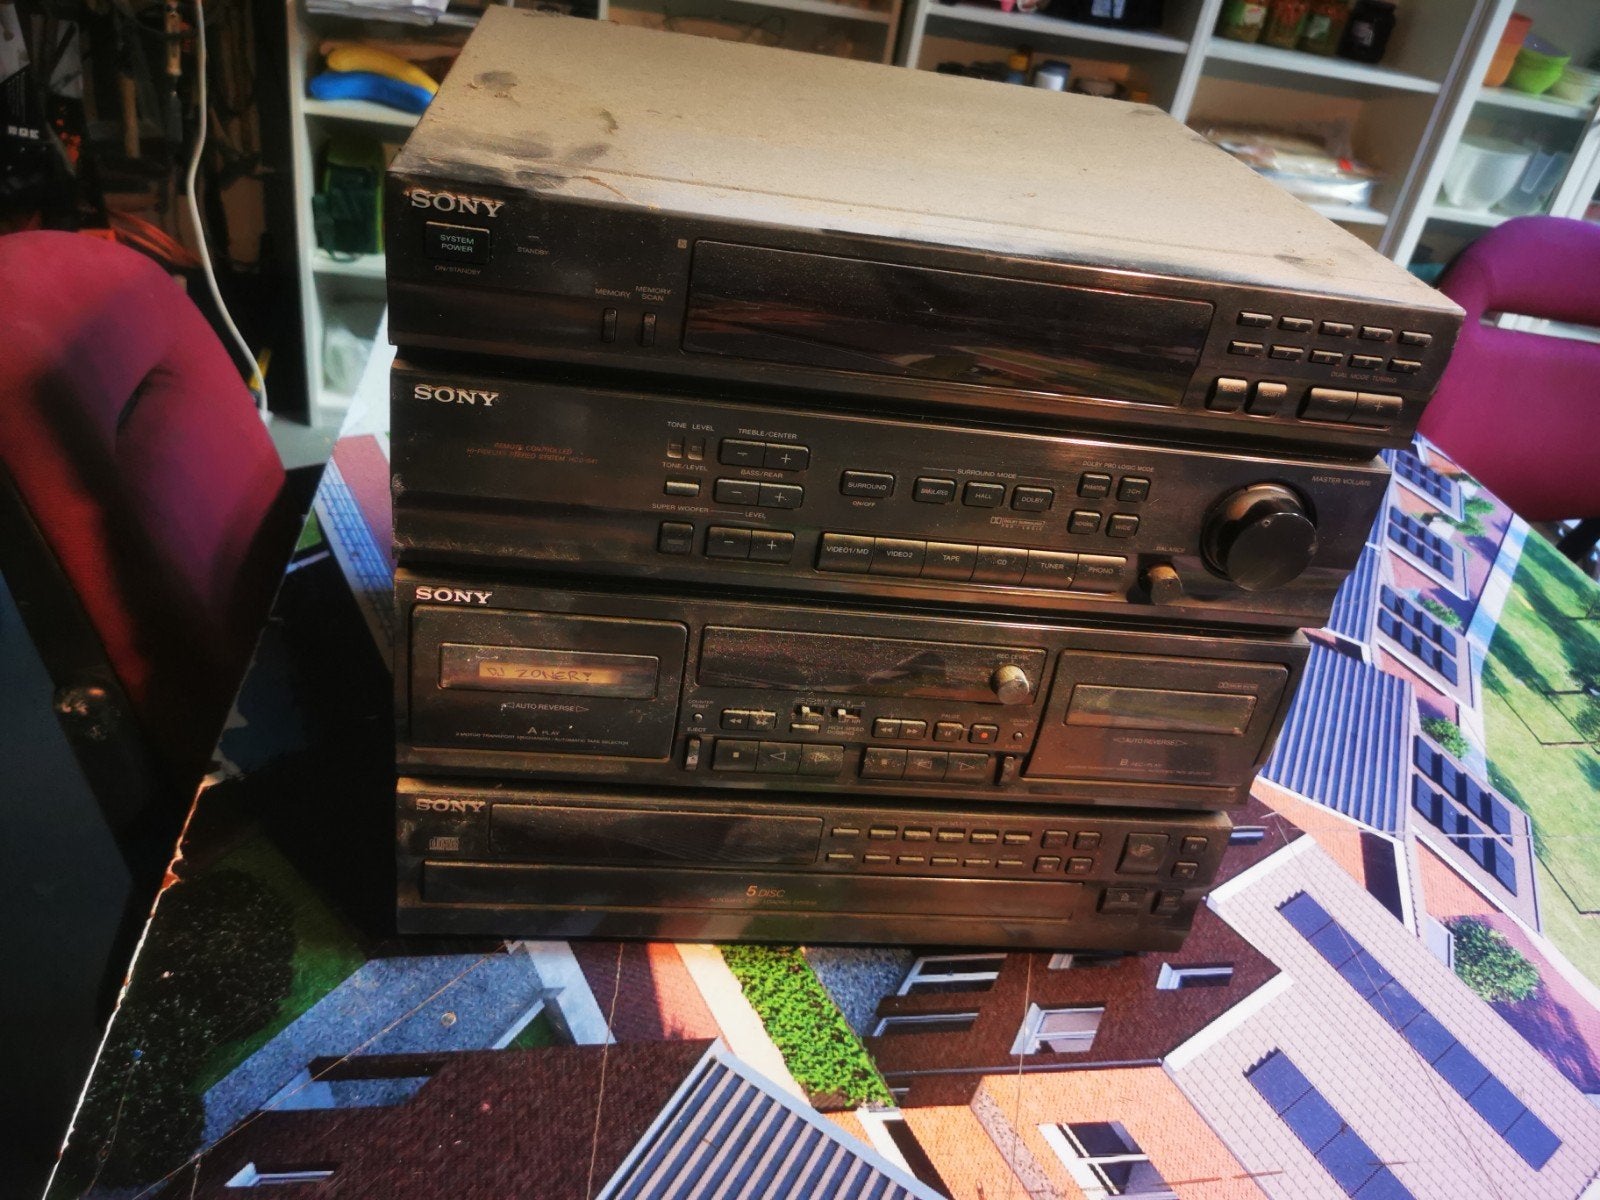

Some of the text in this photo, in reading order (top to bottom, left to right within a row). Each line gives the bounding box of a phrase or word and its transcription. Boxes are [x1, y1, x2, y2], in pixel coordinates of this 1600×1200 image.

[410, 191, 504, 218] SONY
[440, 234, 474, 245] SYSTEM
[441, 243, 473, 253] POWER
[517, 246, 549, 256] STANDBY
[435, 265, 481, 276] ON/STANDBY
[595, 287, 631, 299] MEMORY
[635, 285, 672, 295] MEMORY
[641, 293, 664, 302] SCAN
[413, 384, 500, 407] SONY
[667, 421, 715, 433] TONE LEVEL
[737, 428, 799, 439] TREBLE/CENTER
[662, 462, 709, 471] TONE/LEVEL
[740, 469, 784, 478] BASS/REAR
[956, 468, 1018, 480] SURROUND MODE
[847, 481, 887, 491] SURROUND
[974, 492, 993, 500] HALL
[1021, 495, 1045, 504] DOLBY
[650, 503, 710, 514] SUPER WOOFER
[745, 511, 767, 521] LEVEL
[826, 545, 869, 555] VIDEO1/MD
[886, 550, 913, 559] VIDEO2
[942, 553, 960, 562] TAPE
[996, 559, 1008, 567] CD
[1039, 562, 1065, 571] TUNER
[1088, 566, 1114, 576] PHONO
[415, 585, 493, 605] SONY
[515, 703, 575, 713] AUTO REVERSE
[527, 726, 538, 735] A
[1126, 737, 1175, 746] AUTO REVERSE
[416, 798, 487, 813] SONY
[745, 884, 786, 898] 5 DISC
